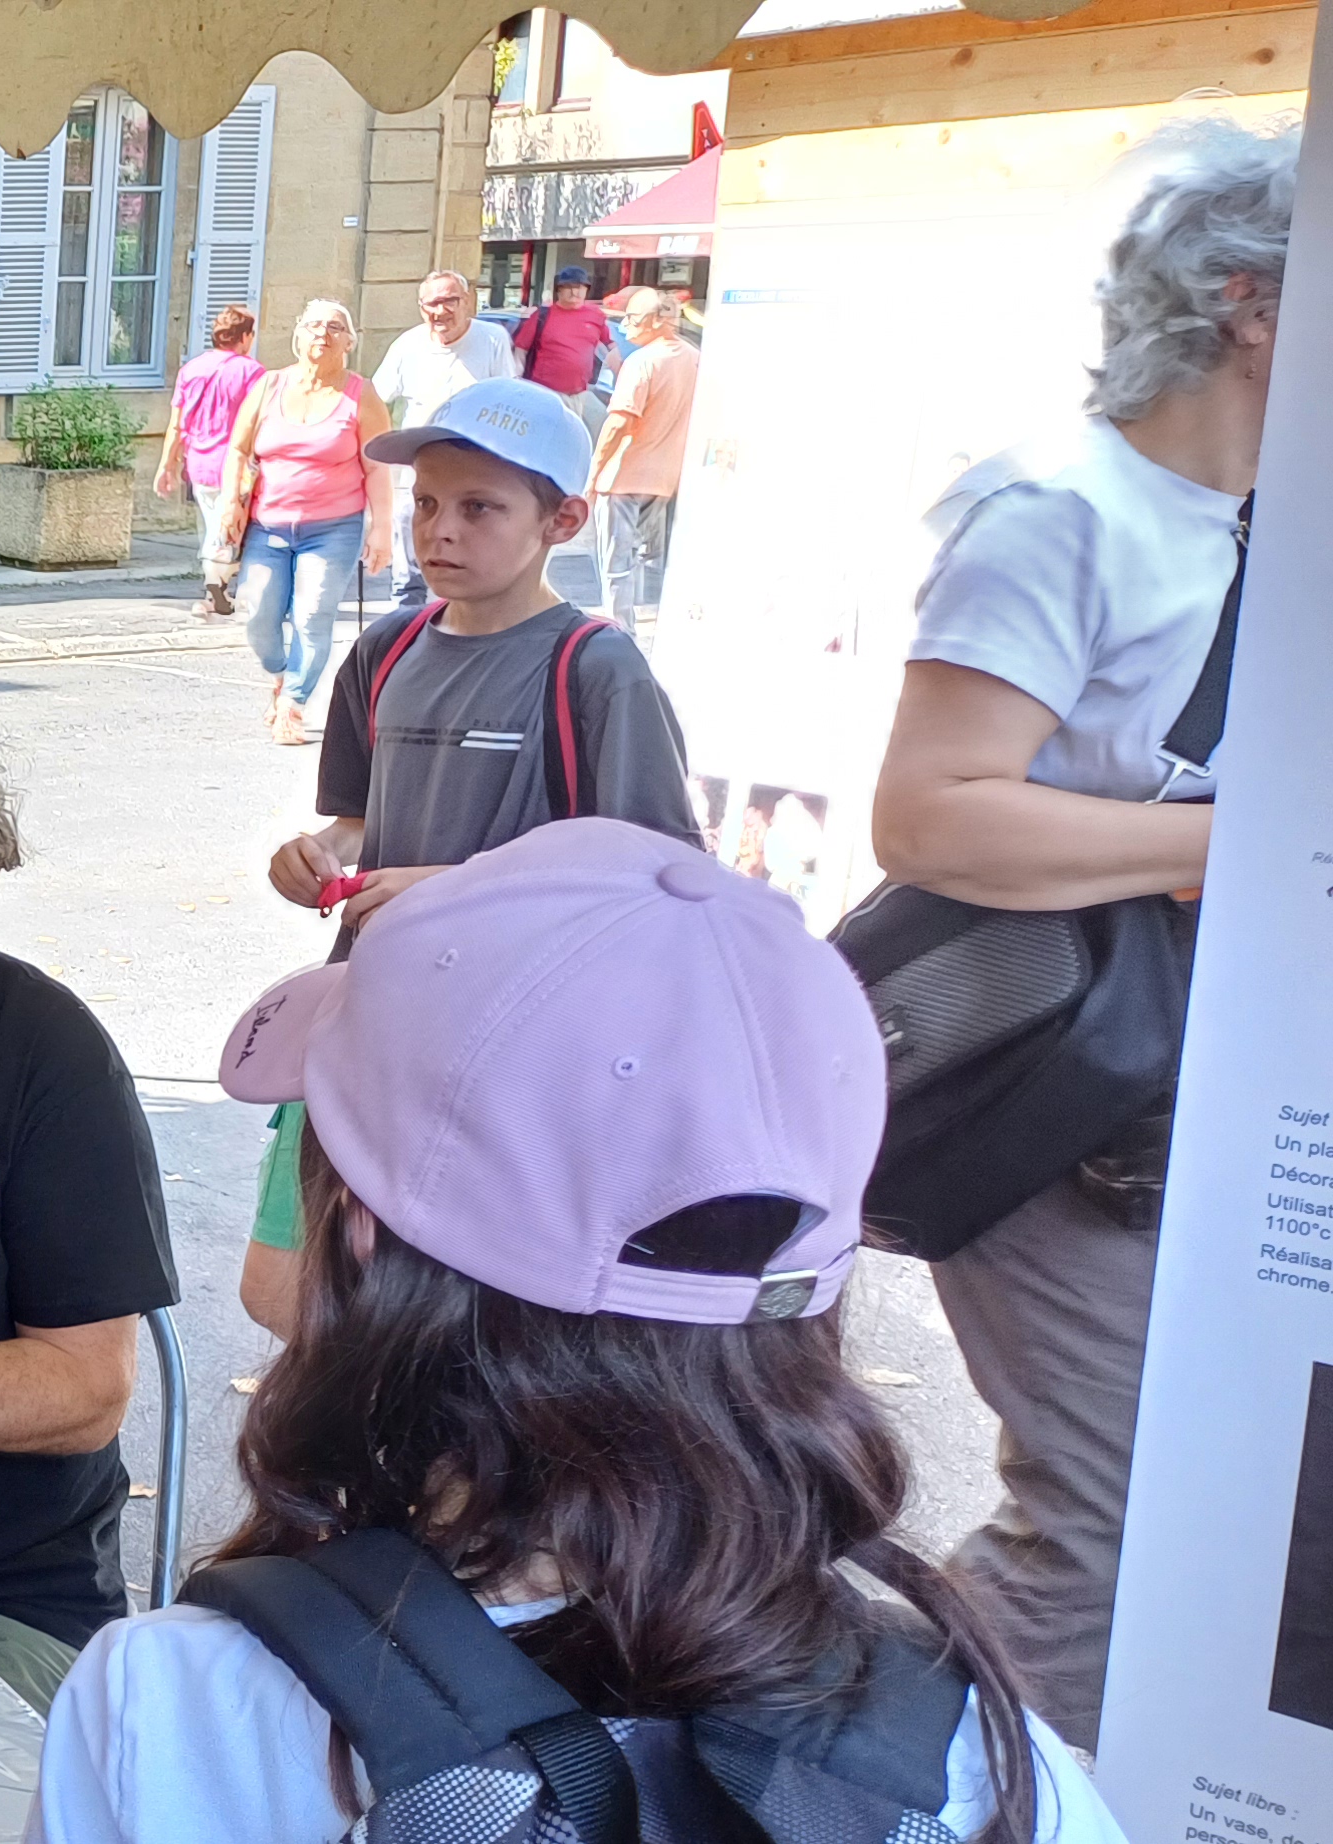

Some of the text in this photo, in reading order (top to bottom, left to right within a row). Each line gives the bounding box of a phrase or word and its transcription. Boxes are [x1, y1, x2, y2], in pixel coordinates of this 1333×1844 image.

[476, 407, 529, 437] PARIS
[1278, 1105, 1331, 1127] Sujet
[1274, 1134, 1302, 1152] Un
[1265, 1215, 1331, 1241] 1100°c
[1193, 1776, 1241, 1802] Sujet
[1245, 1792, 1286, 1816] libre
[1190, 1802, 1215, 1823] Un
